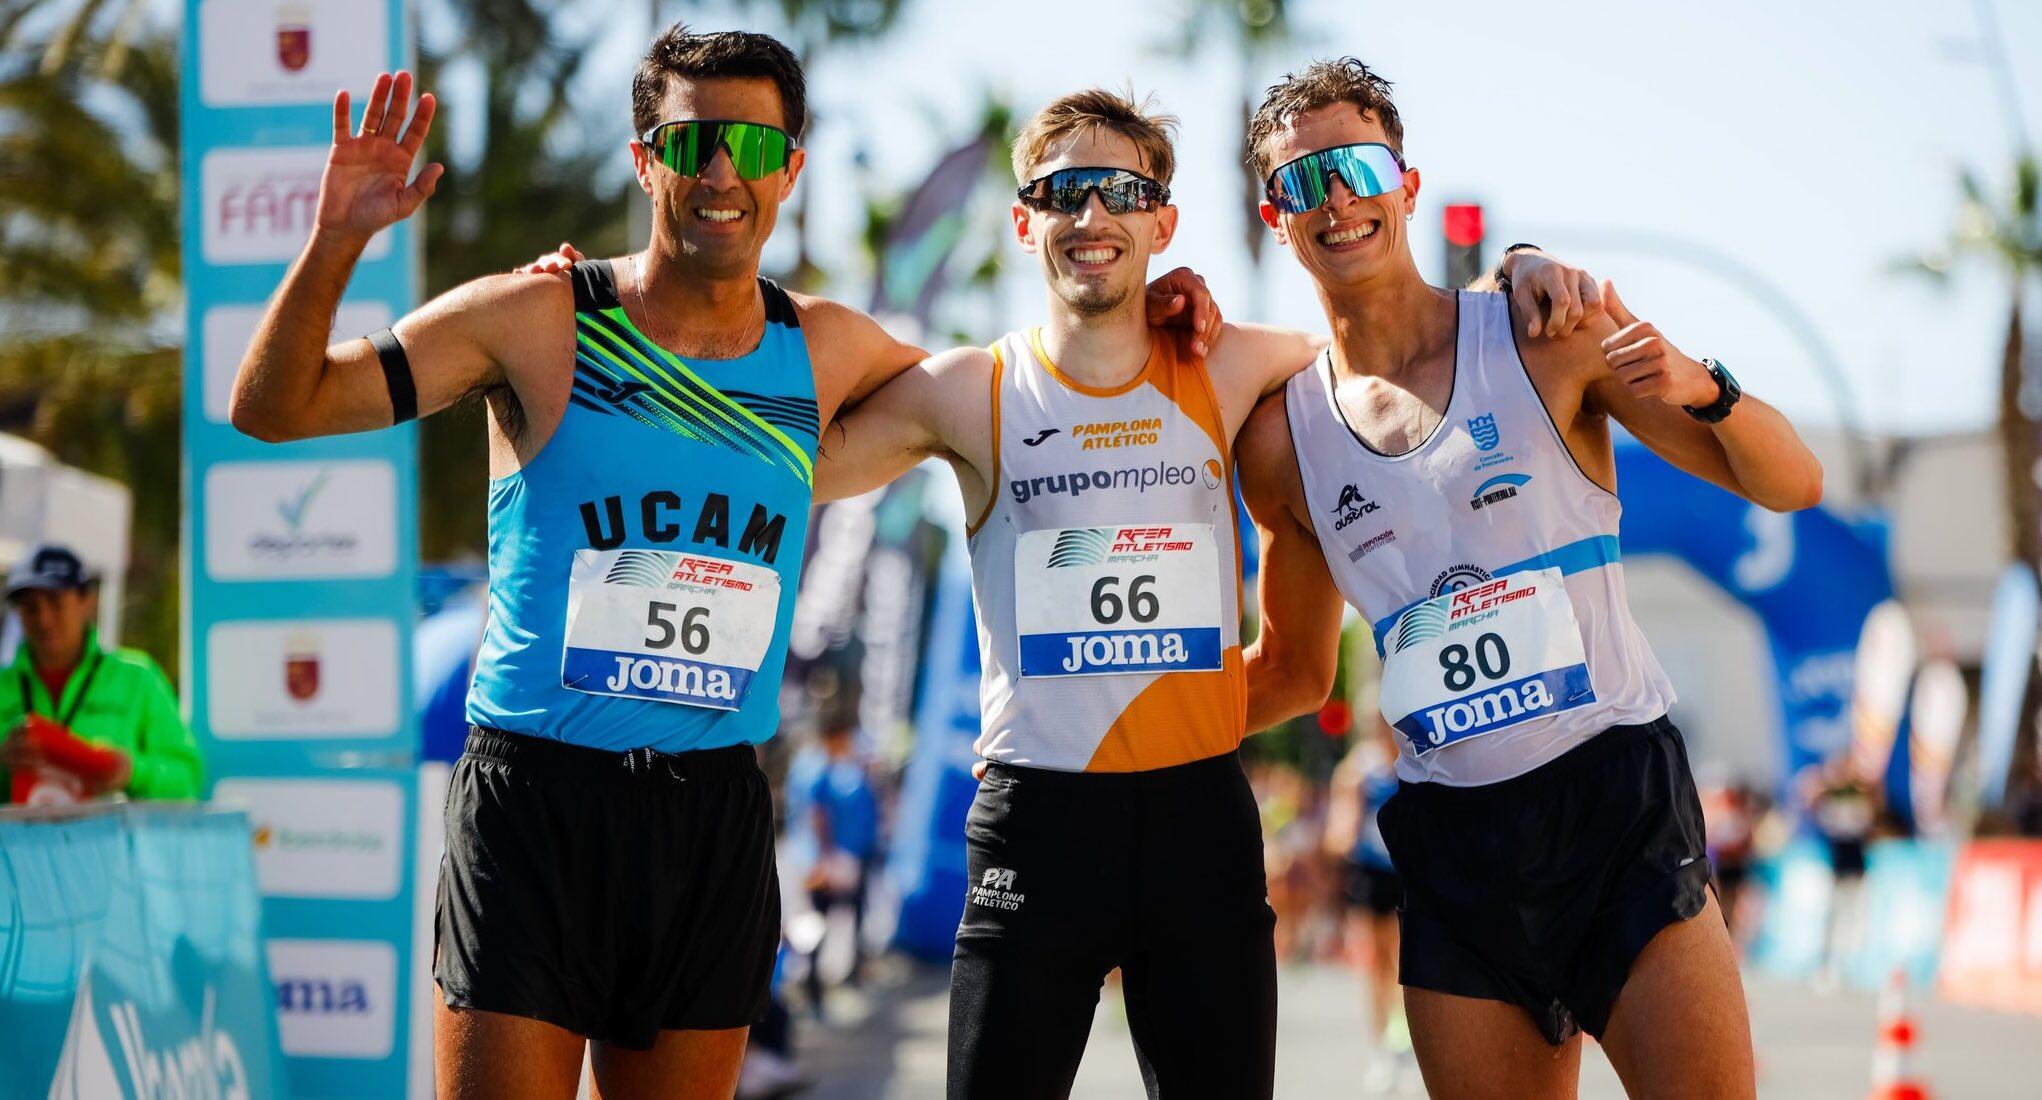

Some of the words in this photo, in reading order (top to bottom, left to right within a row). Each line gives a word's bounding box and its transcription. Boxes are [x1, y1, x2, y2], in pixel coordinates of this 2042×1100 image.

[1072, 418, 1162, 438] PAMPLONA
[1082, 432, 1158, 450] ATLÉTICO
[1011, 461, 1196, 504] grupompleo
[1335, 500, 1381, 531] austral
[579, 490, 787, 565] UCAM
[1117, 527, 1173, 543] RFEA
[1111, 541, 1194, 553] ATLETISMO
[678, 557, 735, 576] RFEA
[1106, 554, 1159, 564] MARCHA
[672, 571, 754, 592] ATLETISMO
[1448, 563, 1493, 582] GIMNÁSTIC
[1090, 574, 1160, 625] 66
[1450, 586, 1537, 620] ATLETISMO
[1452, 579, 1508, 607] RFEA
[644, 600, 711, 656] 56
[1448, 609, 1499, 632] MARCHA
[1438, 632, 1511, 692] 80
[971, 886, 1026, 904] PAMPLONA
